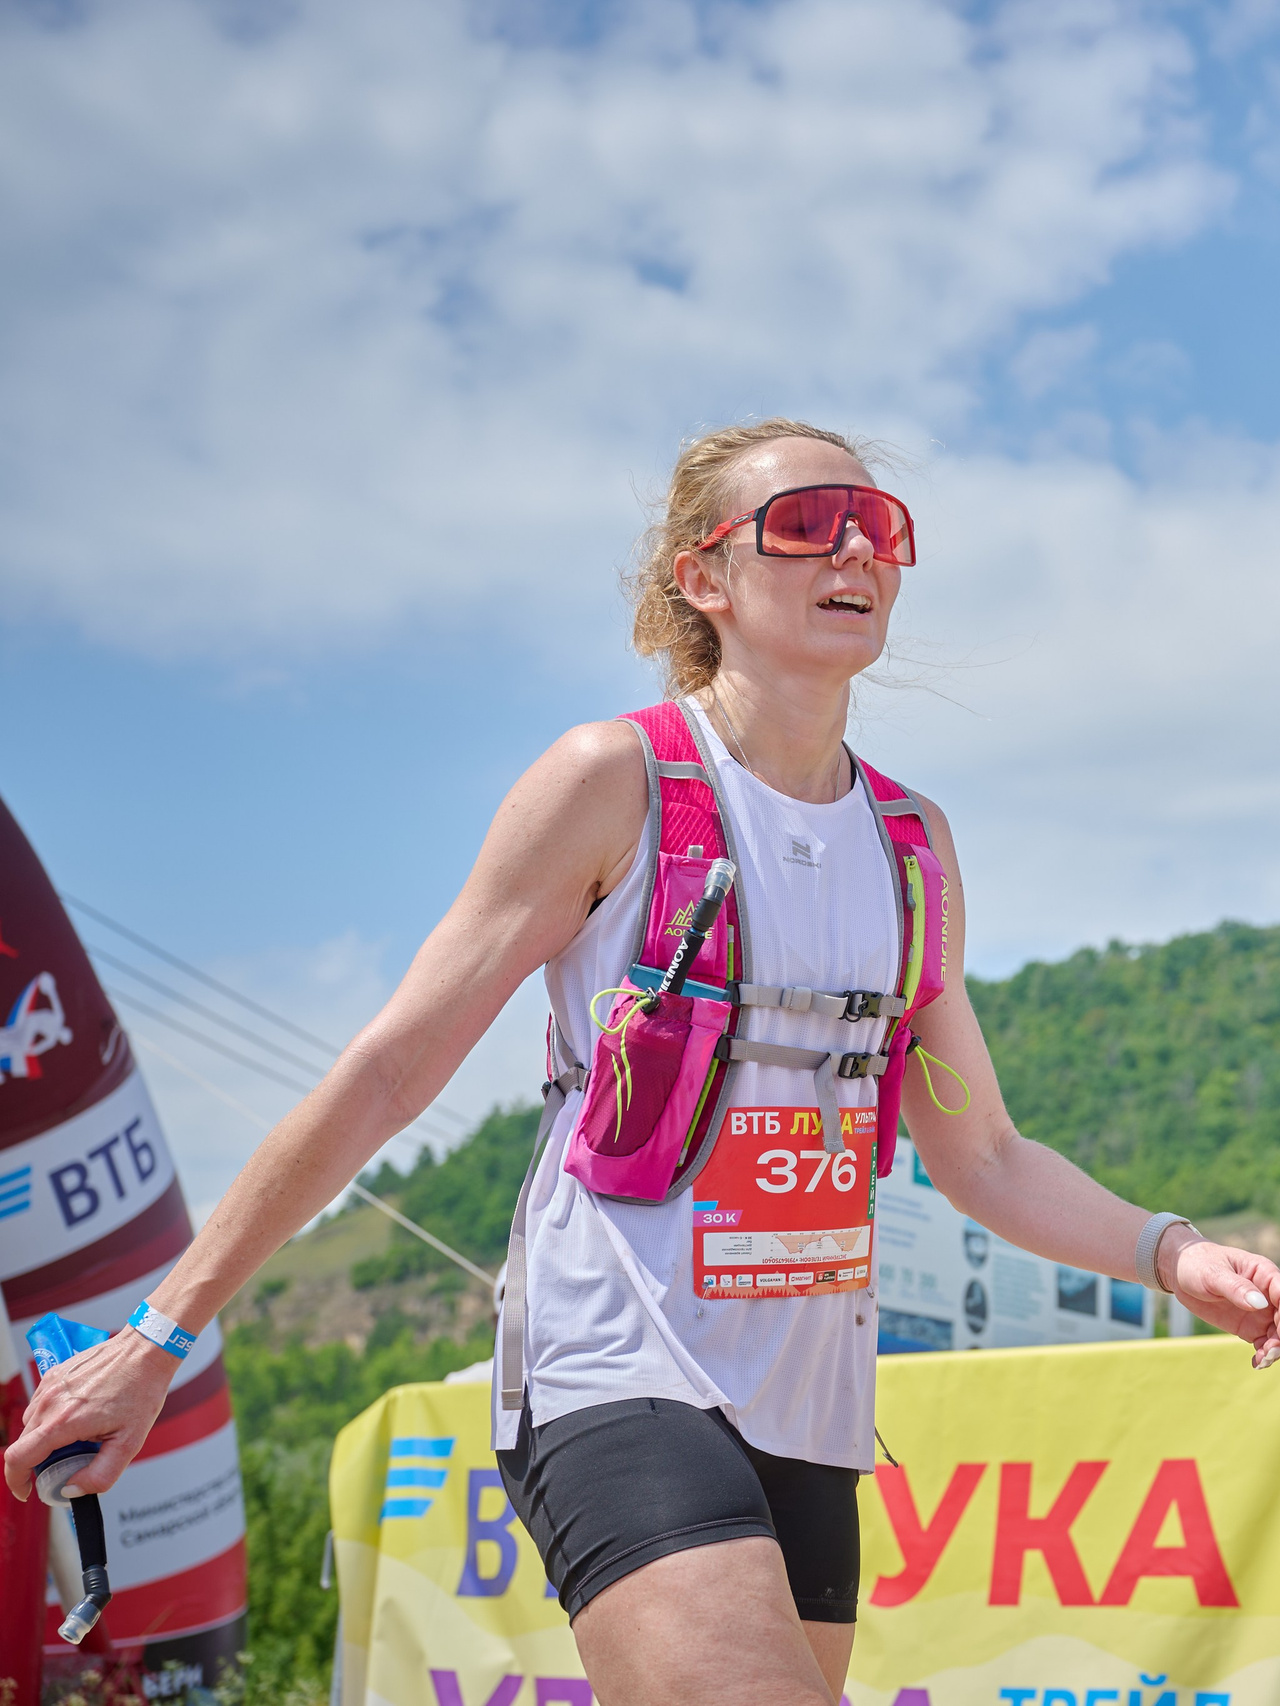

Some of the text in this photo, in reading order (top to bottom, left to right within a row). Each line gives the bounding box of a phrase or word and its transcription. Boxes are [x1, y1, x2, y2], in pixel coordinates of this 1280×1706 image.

[782, 856, 822, 869] NORDSKI
[940, 875, 949, 982] AONIJIE
[731, 1112, 781, 1135] ВТБ
[790, 1112, 854, 1136] ЛУА
[47, 1114, 156, 1231] ВТБ
[756, 1149, 858, 1194] 376
[868, 1146, 877, 1215] ТРЕЙЛ
[703, 1213, 725, 1224] 30
[868, 1458, 1242, 1609] УКА
